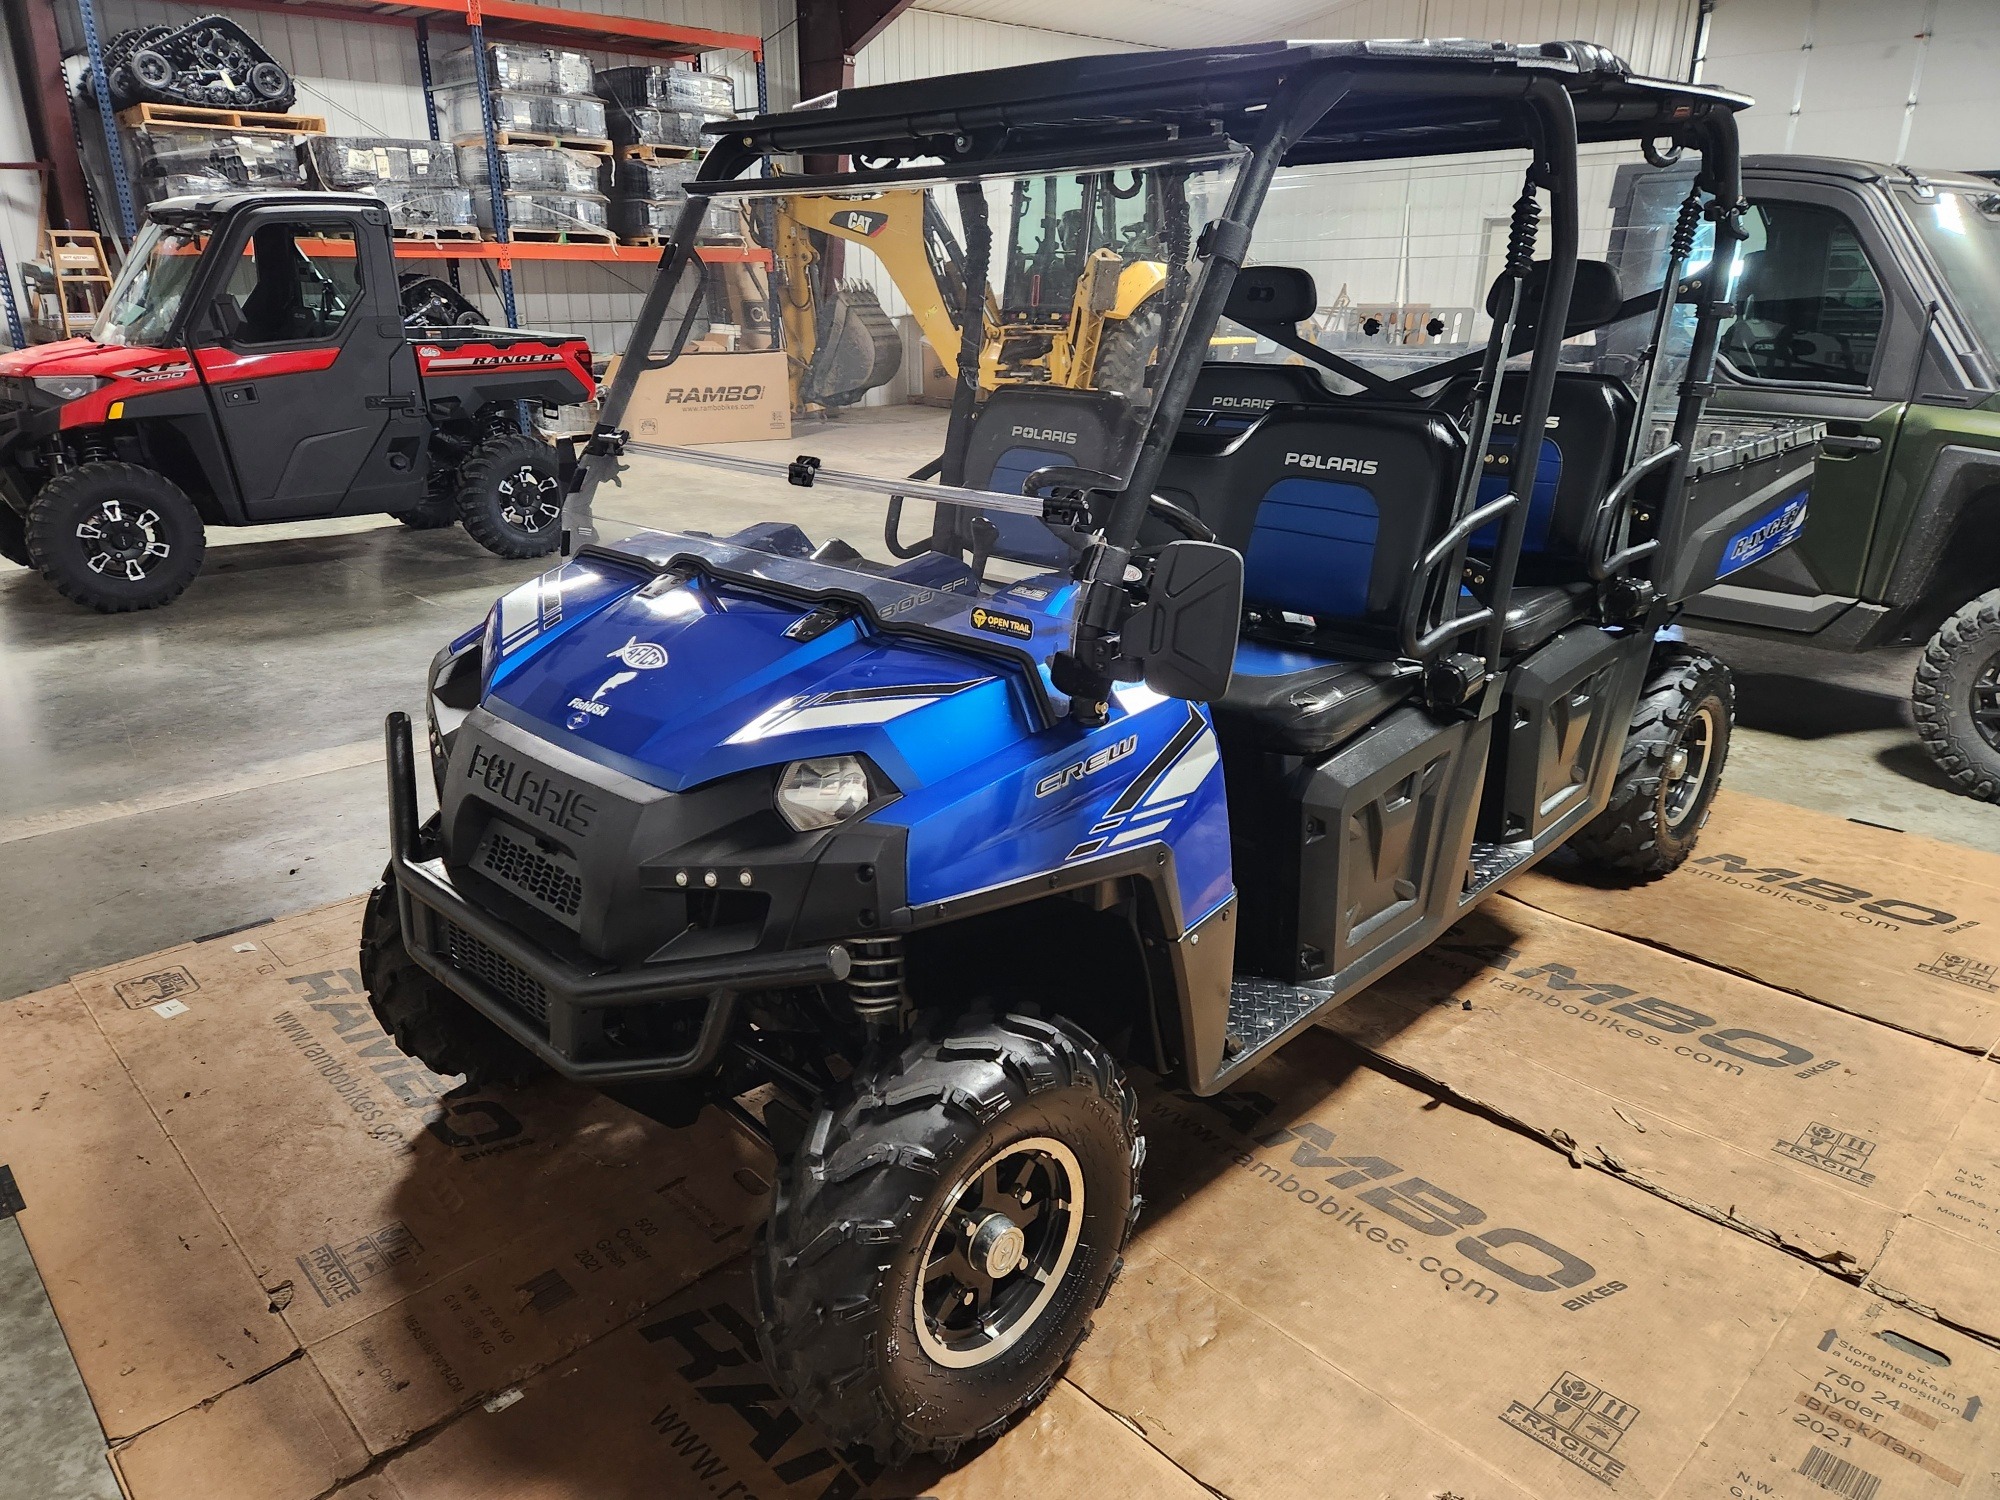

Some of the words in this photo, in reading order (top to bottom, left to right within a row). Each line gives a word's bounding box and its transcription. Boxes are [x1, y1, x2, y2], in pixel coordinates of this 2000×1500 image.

[847, 211, 872, 234] CAT
[129, 361, 190, 376] XP
[472, 354, 555, 365] RANGER
[140, 372, 185, 382] 1000
[665, 385, 761, 404] RAMBO
[682, 404, 755, 412] www.rambobikes.com
[1212, 396, 1275, 410] POLARIS
[1012, 425, 1078, 445] POLARIS
[1285, 453, 1379, 475] POLARIS
[987, 616, 1010, 630] OPEN
[1010, 620, 1031, 634] TRAIL
[567, 697, 610, 717] FishUSA
[1034, 734, 1139, 799] CREW
[467, 744, 598, 838] POLARIS
[1692, 853, 1958, 926] MBO
[1443, 925, 1815, 1068] AMBO
[1795, 1058, 1841, 1080] BIKES
[1775, 1139, 1876, 1184] FRAGILE
[1151, 1102, 1500, 1305] www.rambobikes.com
[1936, 1206, 1971, 1223] Made
[634, 1217, 659, 1238] 500
[595, 1238, 627, 1270] Green
[615, 1227, 652, 1262] Cruiser
[309, 1246, 357, 1302] FRAGILE
[574, 1249, 604, 1273] 2021
[1562, 1279, 1629, 1313] BIKES
[479, 1336, 497, 1356] KG
[498, 1327, 516, 1345] KG
[1832, 1350, 1842, 1358] a
[1845, 1355, 1898, 1384] upright
[1899, 1381, 1961, 1415] position
[1838, 1339, 1877, 1363] Store
[1881, 1360, 1904, 1375] the
[1907, 1372, 1939, 1392] bike
[1943, 1389, 1956, 1401] in
[1813, 1381, 1886, 1424] Ryder
[1823, 1365, 1866, 1394] 750
[1871, 1390, 1900, 1412] 24
[1506, 1402, 1625, 1479] FRAGILE
[1793, 1412, 1853, 1449] 2021
[1805, 1396, 1924, 1465] Black/Tan
[1501, 1412, 1533, 1434] PLEASE
[1533, 1431, 1567, 1455] HANDLE
[1567, 1452, 1590, 1468] WITH
[1589, 1465, 1615, 1483] CARE
